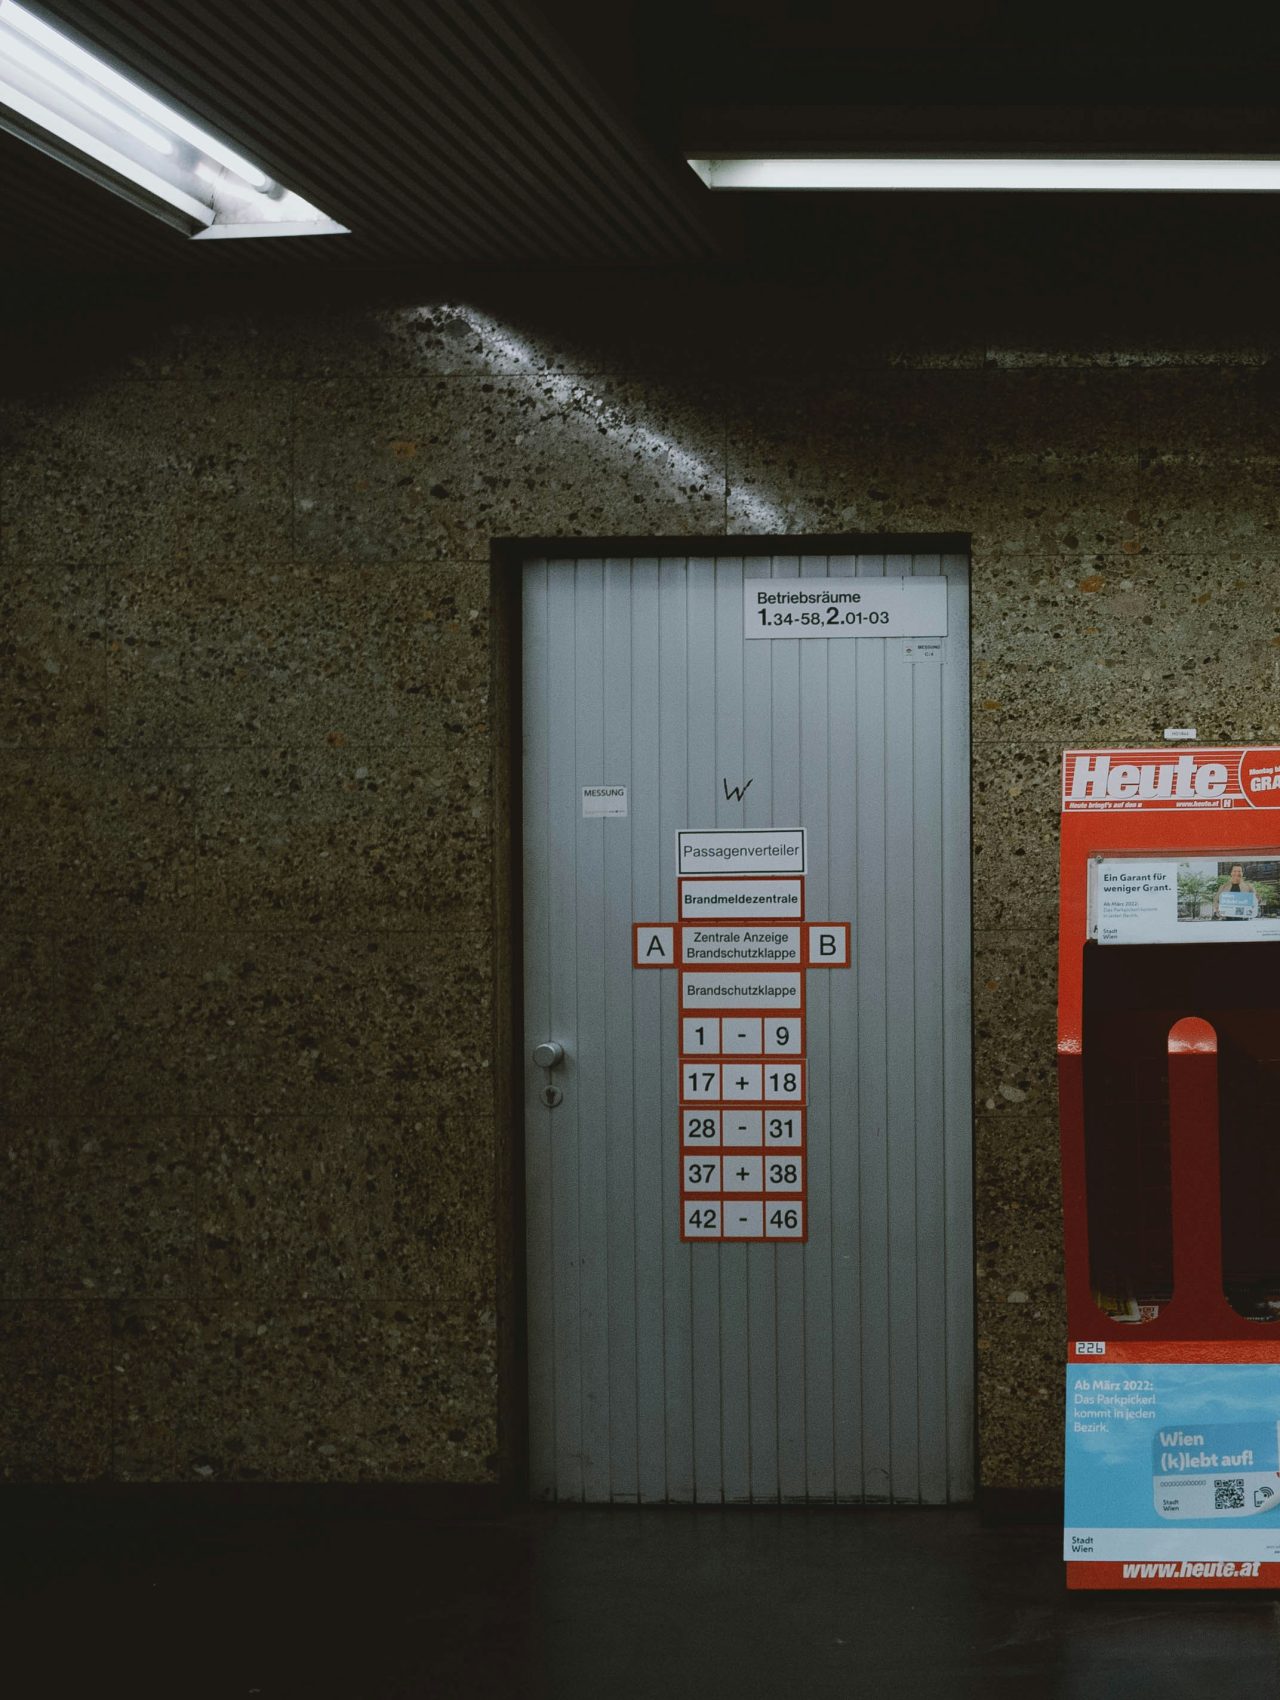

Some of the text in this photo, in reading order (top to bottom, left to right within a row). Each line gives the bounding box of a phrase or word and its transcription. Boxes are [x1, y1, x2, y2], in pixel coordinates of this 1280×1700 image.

[757, 591, 861, 605] Betriebsräume
[757, 606, 890, 627] 1.34-58,2.01-03
[1070, 755, 1229, 801] Heute
[584, 789, 624, 797] MESSUNG
[723, 777, 754, 802] W
[683, 844, 799, 860] Passagenverteiler
[1103, 872, 1167, 882] Ein Garant für
[1103, 883, 1172, 894] weniger Grant.
[684, 894, 799, 905] Brandmeldezentrale
[693, 932, 789, 945] Zentrale Anzeige
[819, 934, 837, 956] B
[646, 935, 666, 957] A
[686, 947, 796, 960] Brandschutzklappe
[686, 985, 797, 998] Brandschutzklappe
[695, 1027, 705, 1045] 1
[775, 1026, 789, 1046] 9
[688, 1073, 716, 1091] 17
[769, 1073, 797, 1092] 18
[688, 1118, 716, 1138] 28
[769, 1118, 794, 1138] 31
[688, 1164, 716, 1184] 37
[769, 1164, 798, 1184] 38
[688, 1210, 717, 1229] 42
[769, 1210, 798, 1229] 46
[1074, 1379, 1154, 1391] Ab März 2022:
[1074, 1394, 1156, 1408] Das Parkpickerl
[1073, 1408, 1156, 1420] kommt in jeden
[1073, 1422, 1110, 1433] Bezirk.
[1159, 1432, 1204, 1447] Wien
[1161, 1450, 1254, 1471] (k)lebt auf!
[1071, 1536, 1094, 1545] Stadt
[1071, 1544, 1094, 1553] Wien
[1122, 1560, 1262, 1579] www.heute.at
